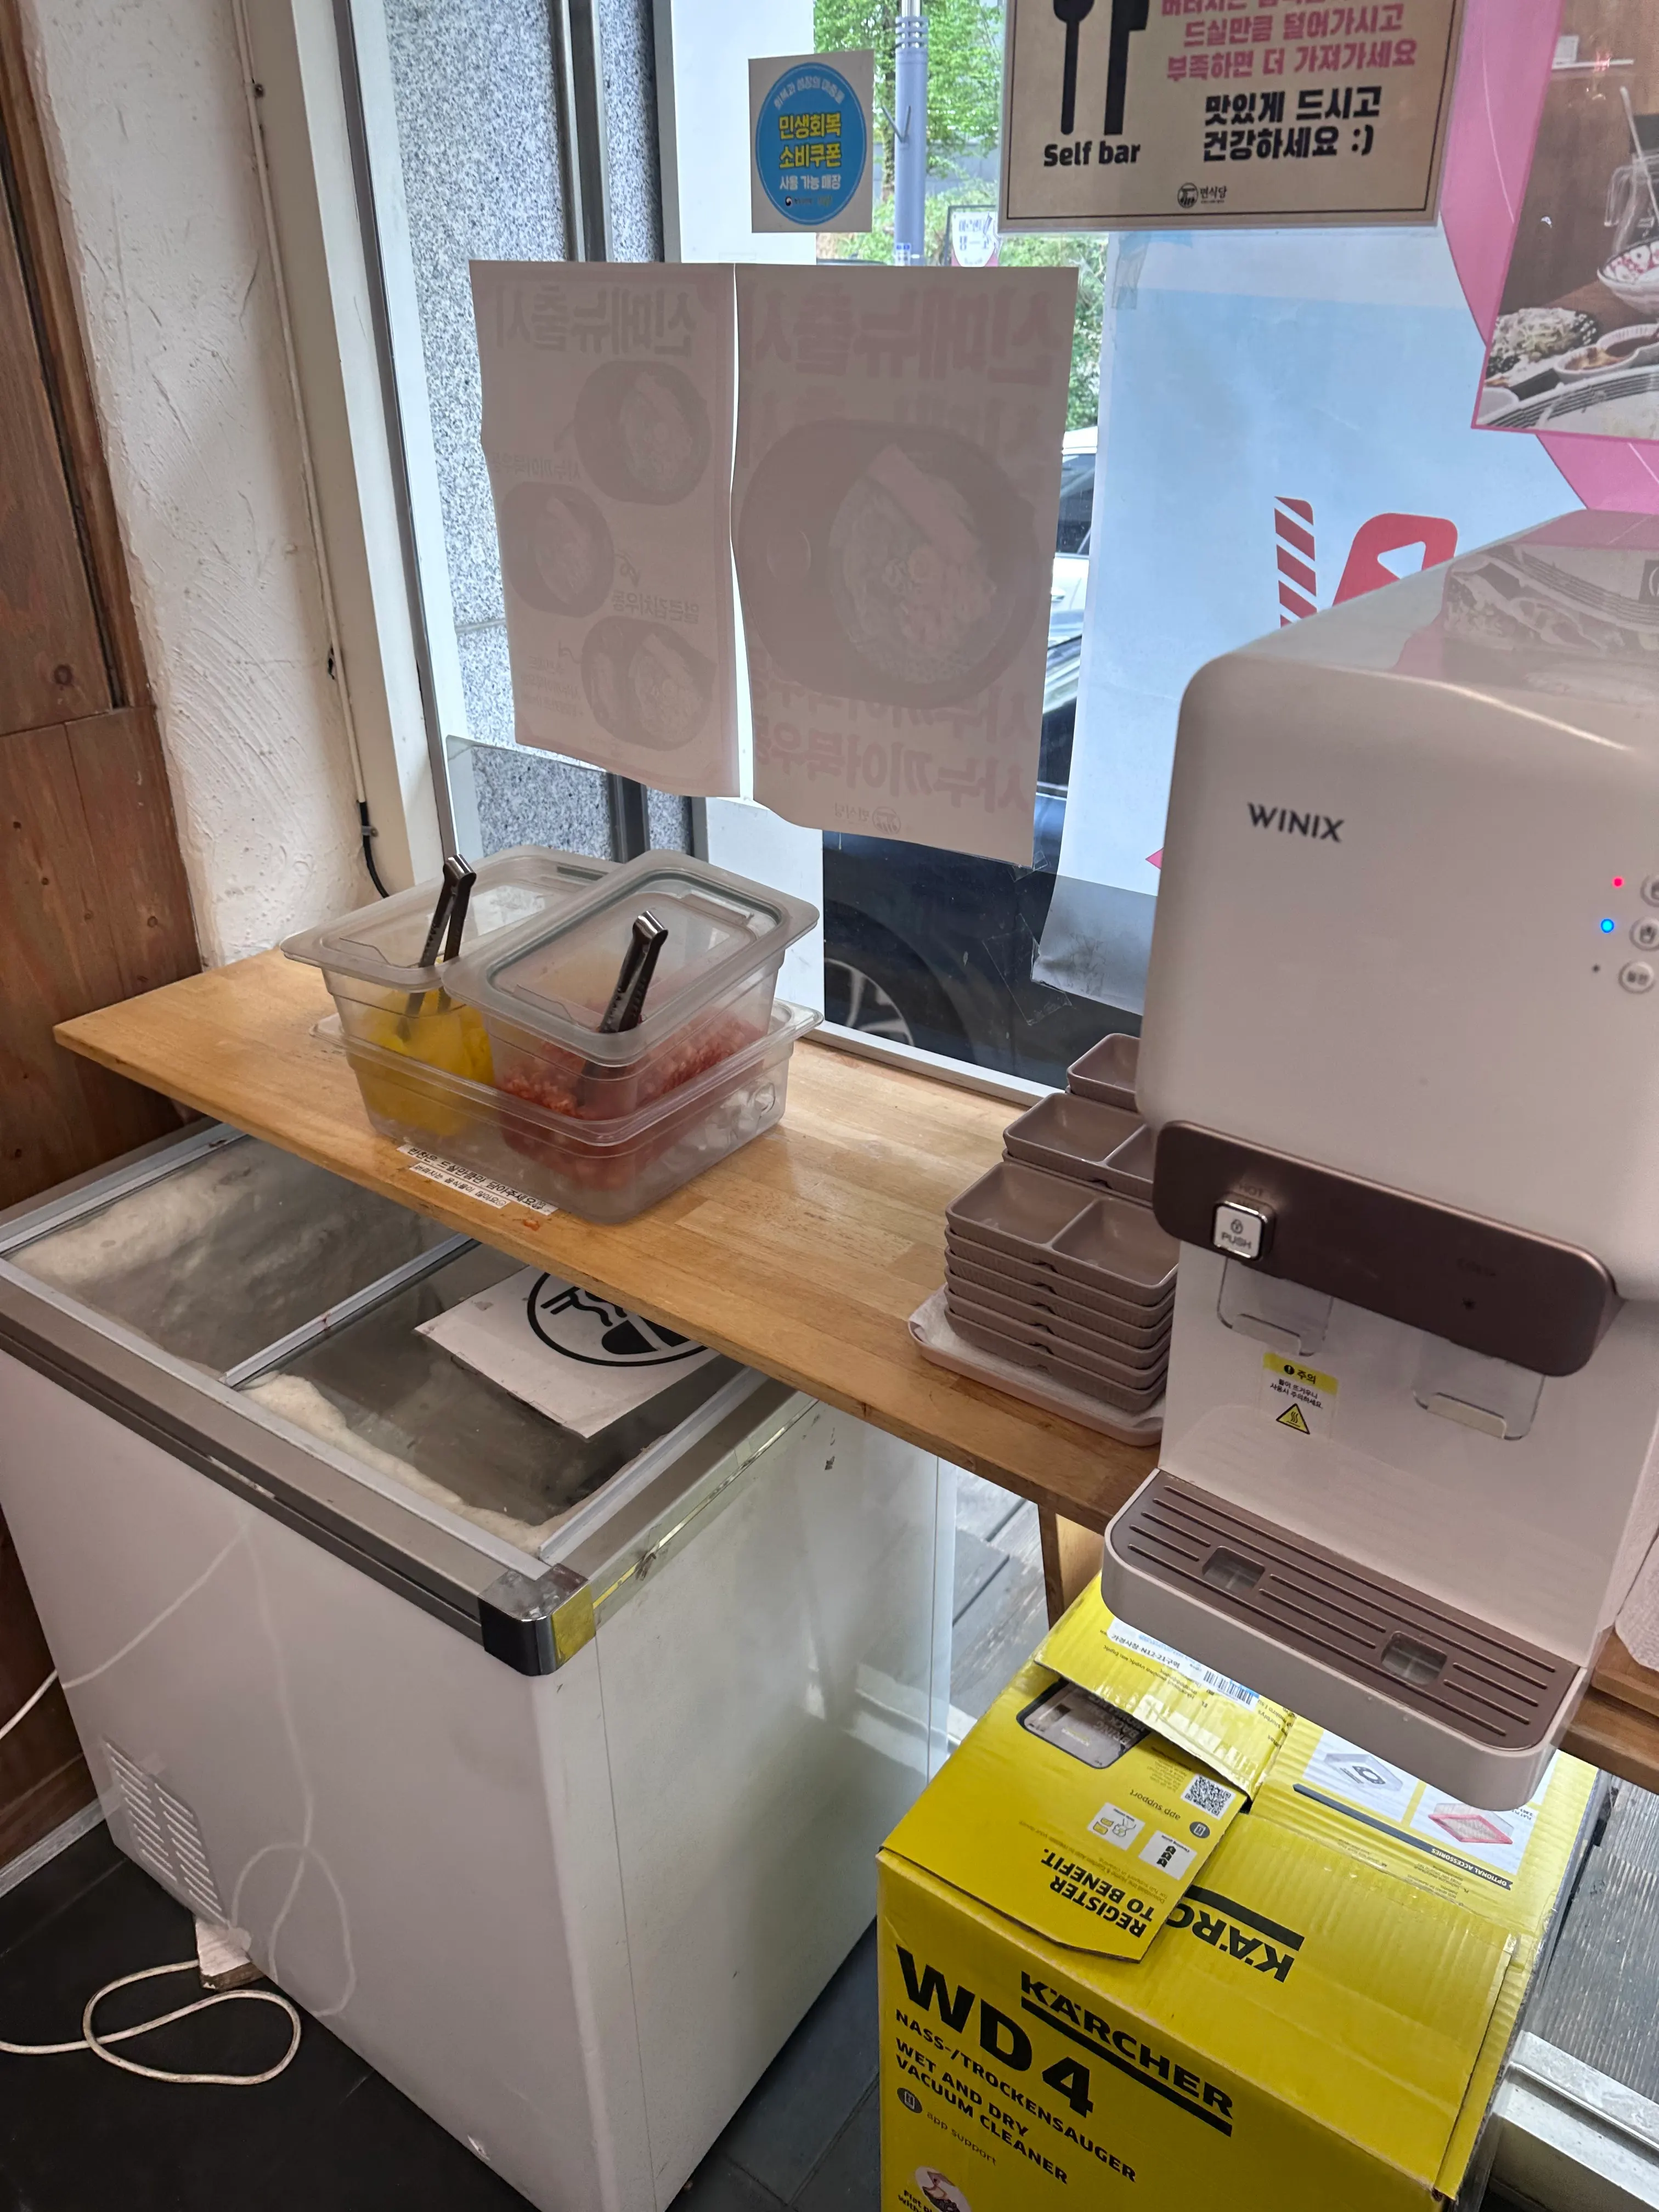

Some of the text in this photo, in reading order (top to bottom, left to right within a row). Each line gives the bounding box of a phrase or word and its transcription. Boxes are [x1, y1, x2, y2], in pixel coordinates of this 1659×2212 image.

[1183, 15, 1273, 47] 드실만큼
[1166, 39, 1418, 82] 부족하면 더 가져가세요
[1205, 86, 1383, 127] 맛있게 드시고
[778, 112, 842, 140] 민생회복
[1203, 126, 1340, 162] 건강하세요
[778, 142, 842, 169] 소비쿠폰
[1043, 140, 1141, 166] Self bar
[780, 174, 841, 190] 사용 가능 매장
[1248, 802, 1344, 843] WINIX
[408, 1147, 438, 1163] 반찬은
[437, 1161, 487, 1184] 드실만큼만
[1221, 1232, 1252, 1249] PUSH
[1270, 1383, 1289, 1396] 사용시
[1297, 1369, 1316, 1384] 주의
[1092, 1719, 1131, 1746] BRING
[1130, 1789, 1181, 1821] app support
[1430, 1847, 1474, 1871] ACCESSORIES
[1472, 1866, 1508, 1887] OPTIONAL
[1041, 1848, 1154, 1922] TO BENEFIT.
[1049, 1875, 1147, 1938] REGISTER
[896, 1944, 1094, 2119] WD 4
[1021, 1971, 1234, 2120] KÄRCHER
[896, 2038, 1029, 2137] WET AND DRY
[896, 2009, 1137, 2183] NASS-/TROCKENSAUGER
[896, 2056, 1068, 2185] VACUUM CLEANER
[926, 2111, 997, 2166] app support
